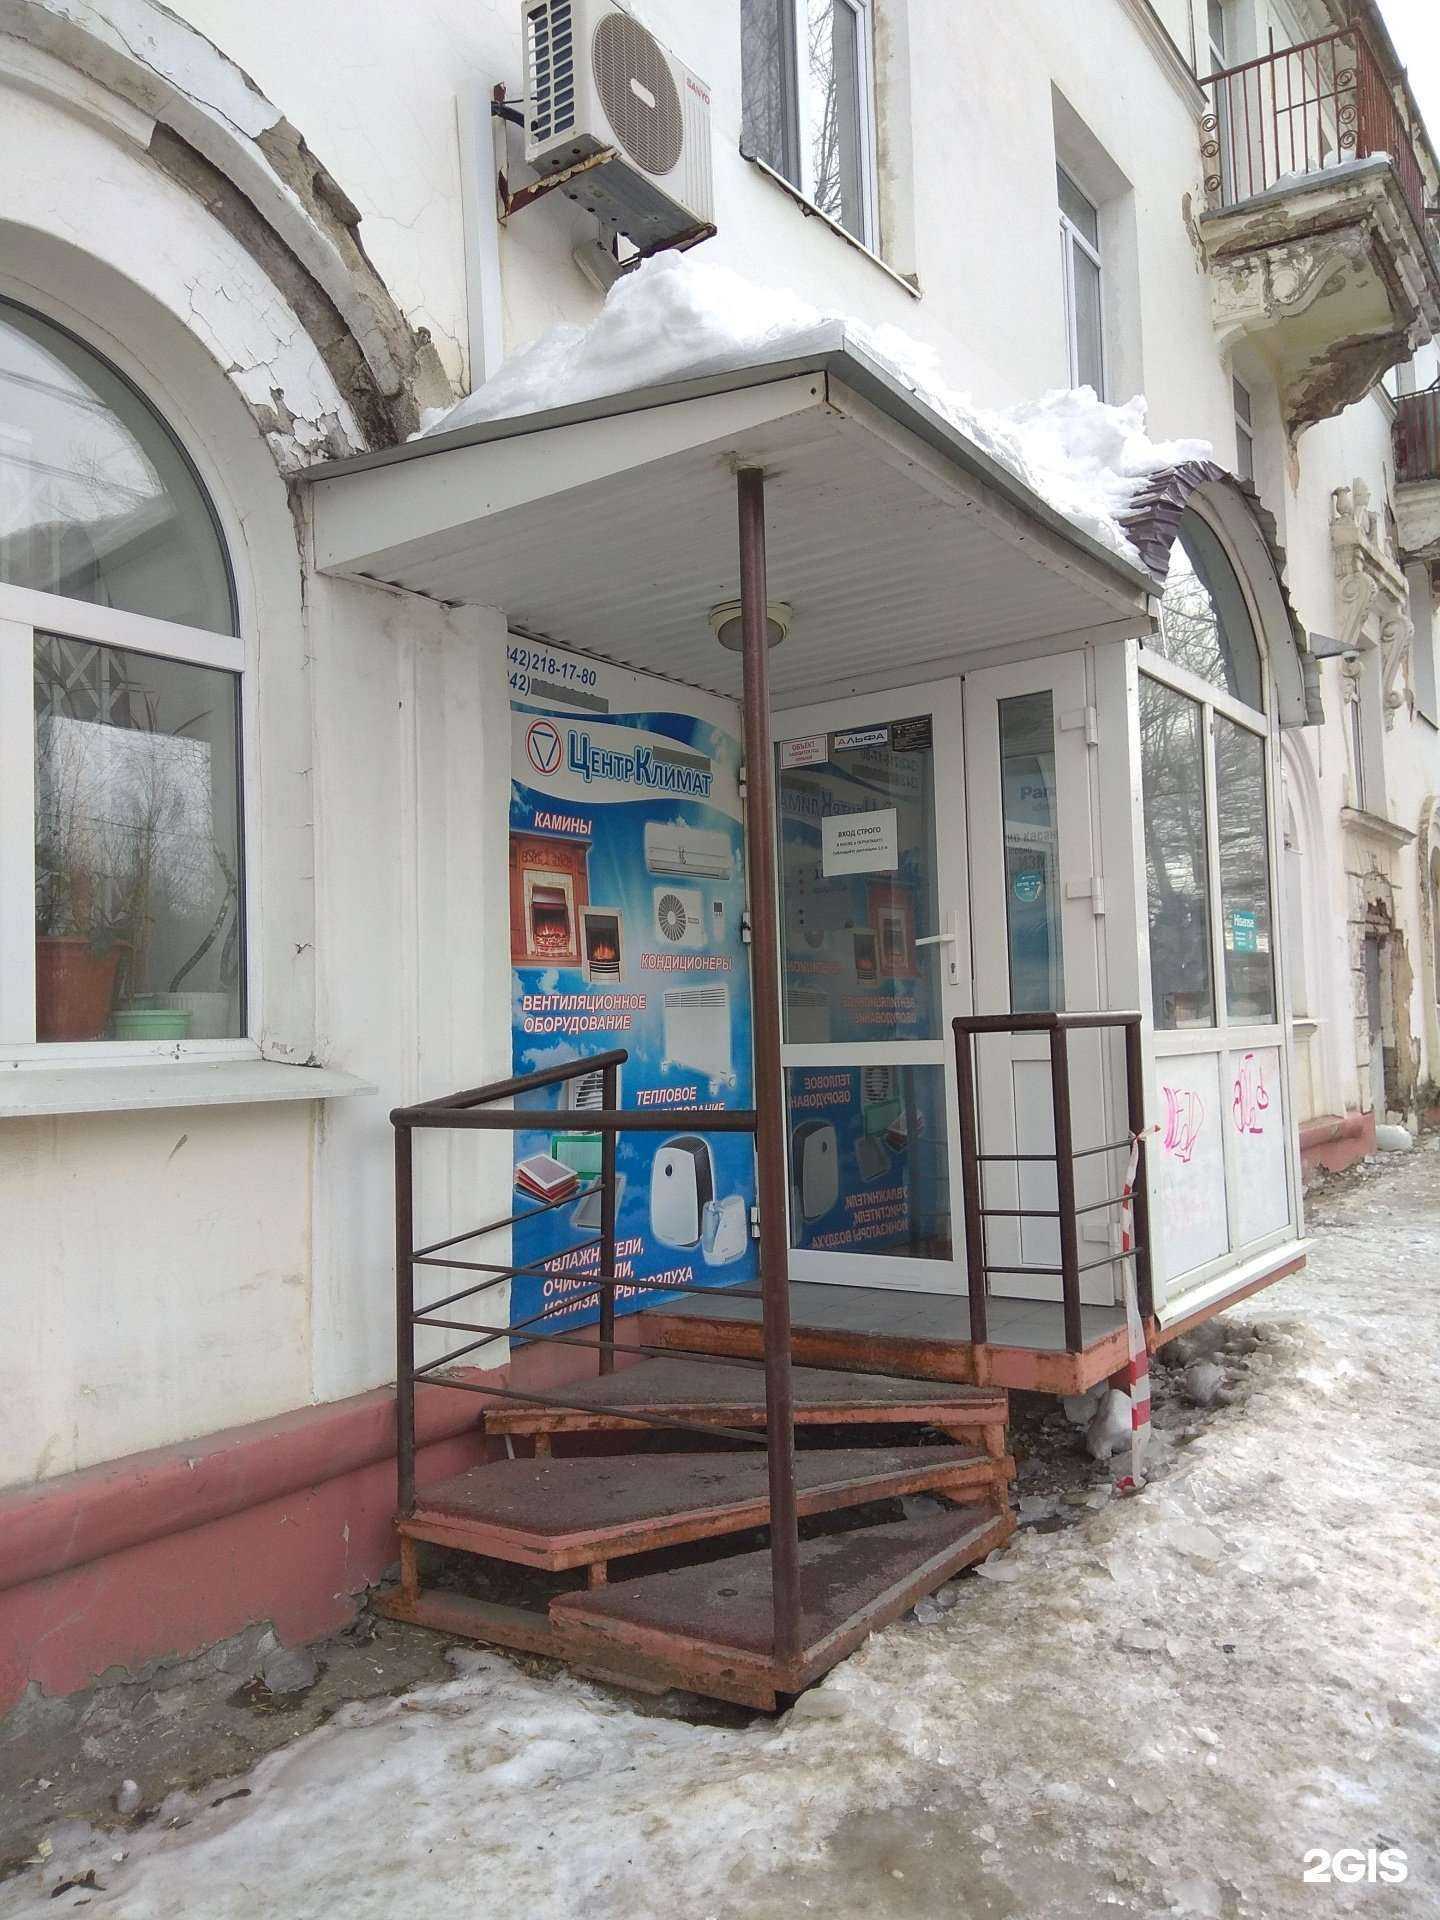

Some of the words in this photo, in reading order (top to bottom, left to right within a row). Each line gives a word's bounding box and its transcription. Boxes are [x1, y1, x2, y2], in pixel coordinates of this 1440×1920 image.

[507, 645, 597, 687] 42)218-17-80
[837, 732, 885, 746] АЛЬФА
[534, 811, 593, 835] КАМИНЫ
[856, 826, 881, 837] СТРОГО
[640, 953, 732, 972] КОНДИЦИОНЕРЫ
[522, 993, 647, 1012] ВЕНТИЛЯЦИОННОЕ
[523, 1015, 632, 1035] ОБОРУДОВАНИЕ
[636, 1086, 697, 1106] ТЕПЛОВОЕ
